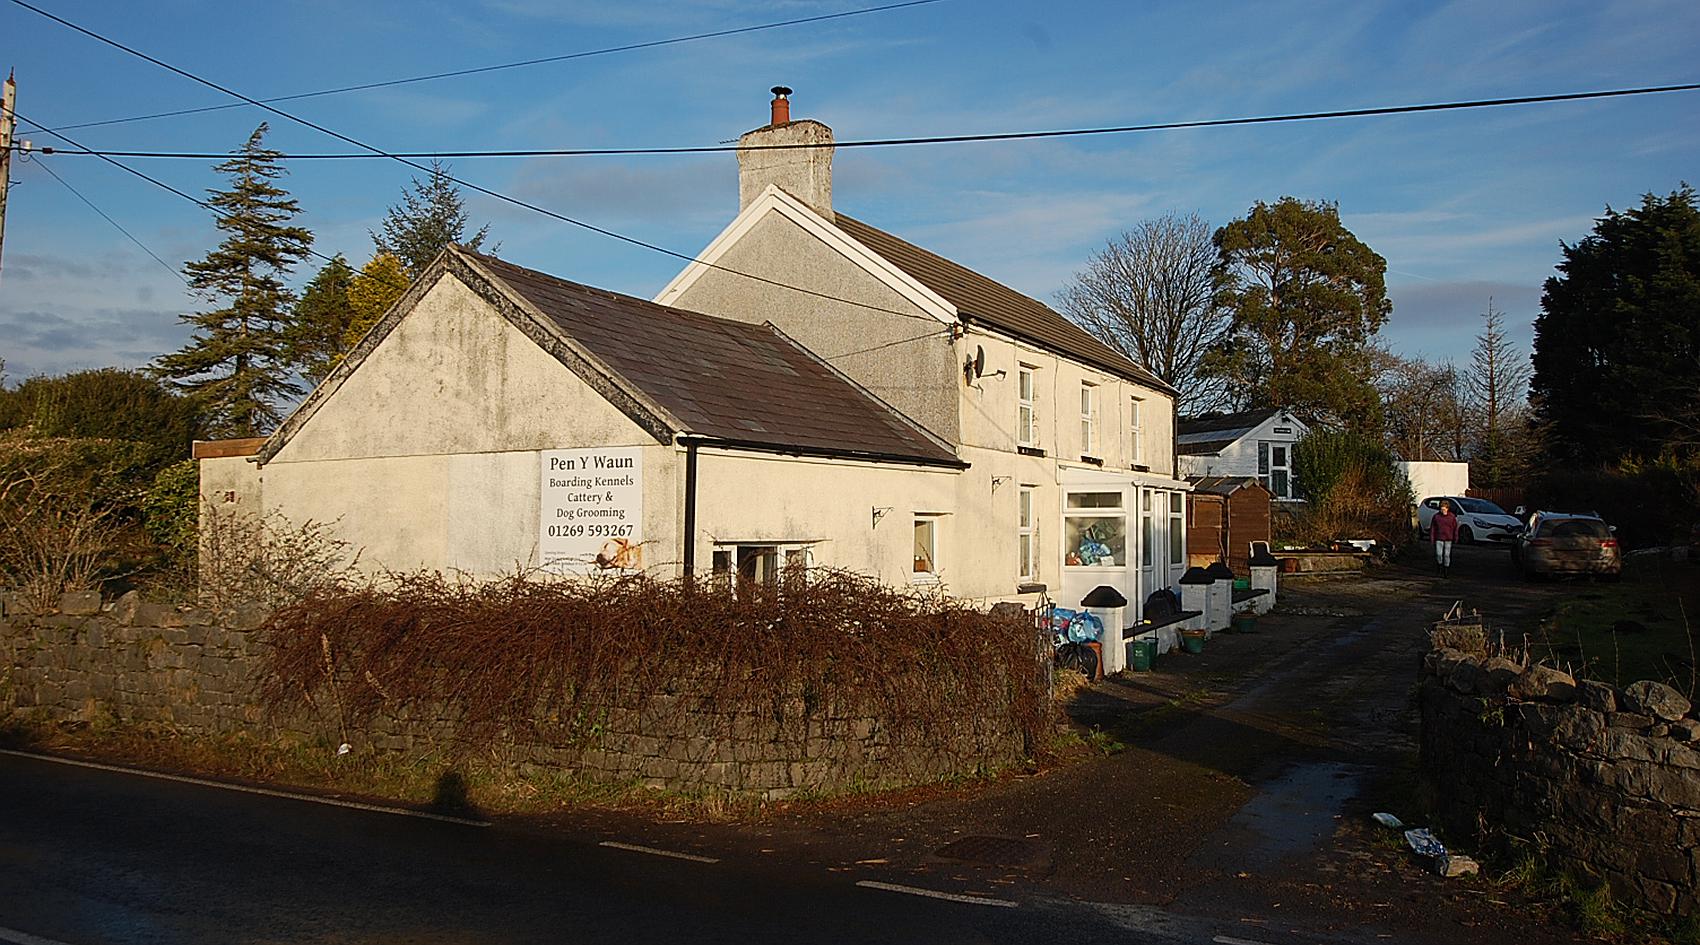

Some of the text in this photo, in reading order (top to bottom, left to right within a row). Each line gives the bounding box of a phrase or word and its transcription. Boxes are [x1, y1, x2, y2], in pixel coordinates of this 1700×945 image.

[550, 455, 633, 471] Pen Y Waun
[549, 475, 634, 489] Boarding Kennels
[567, 491, 613, 505] Cattery &
[556, 507, 625, 520] Dog Grooming
[548, 524, 633, 537] 01269 593267
